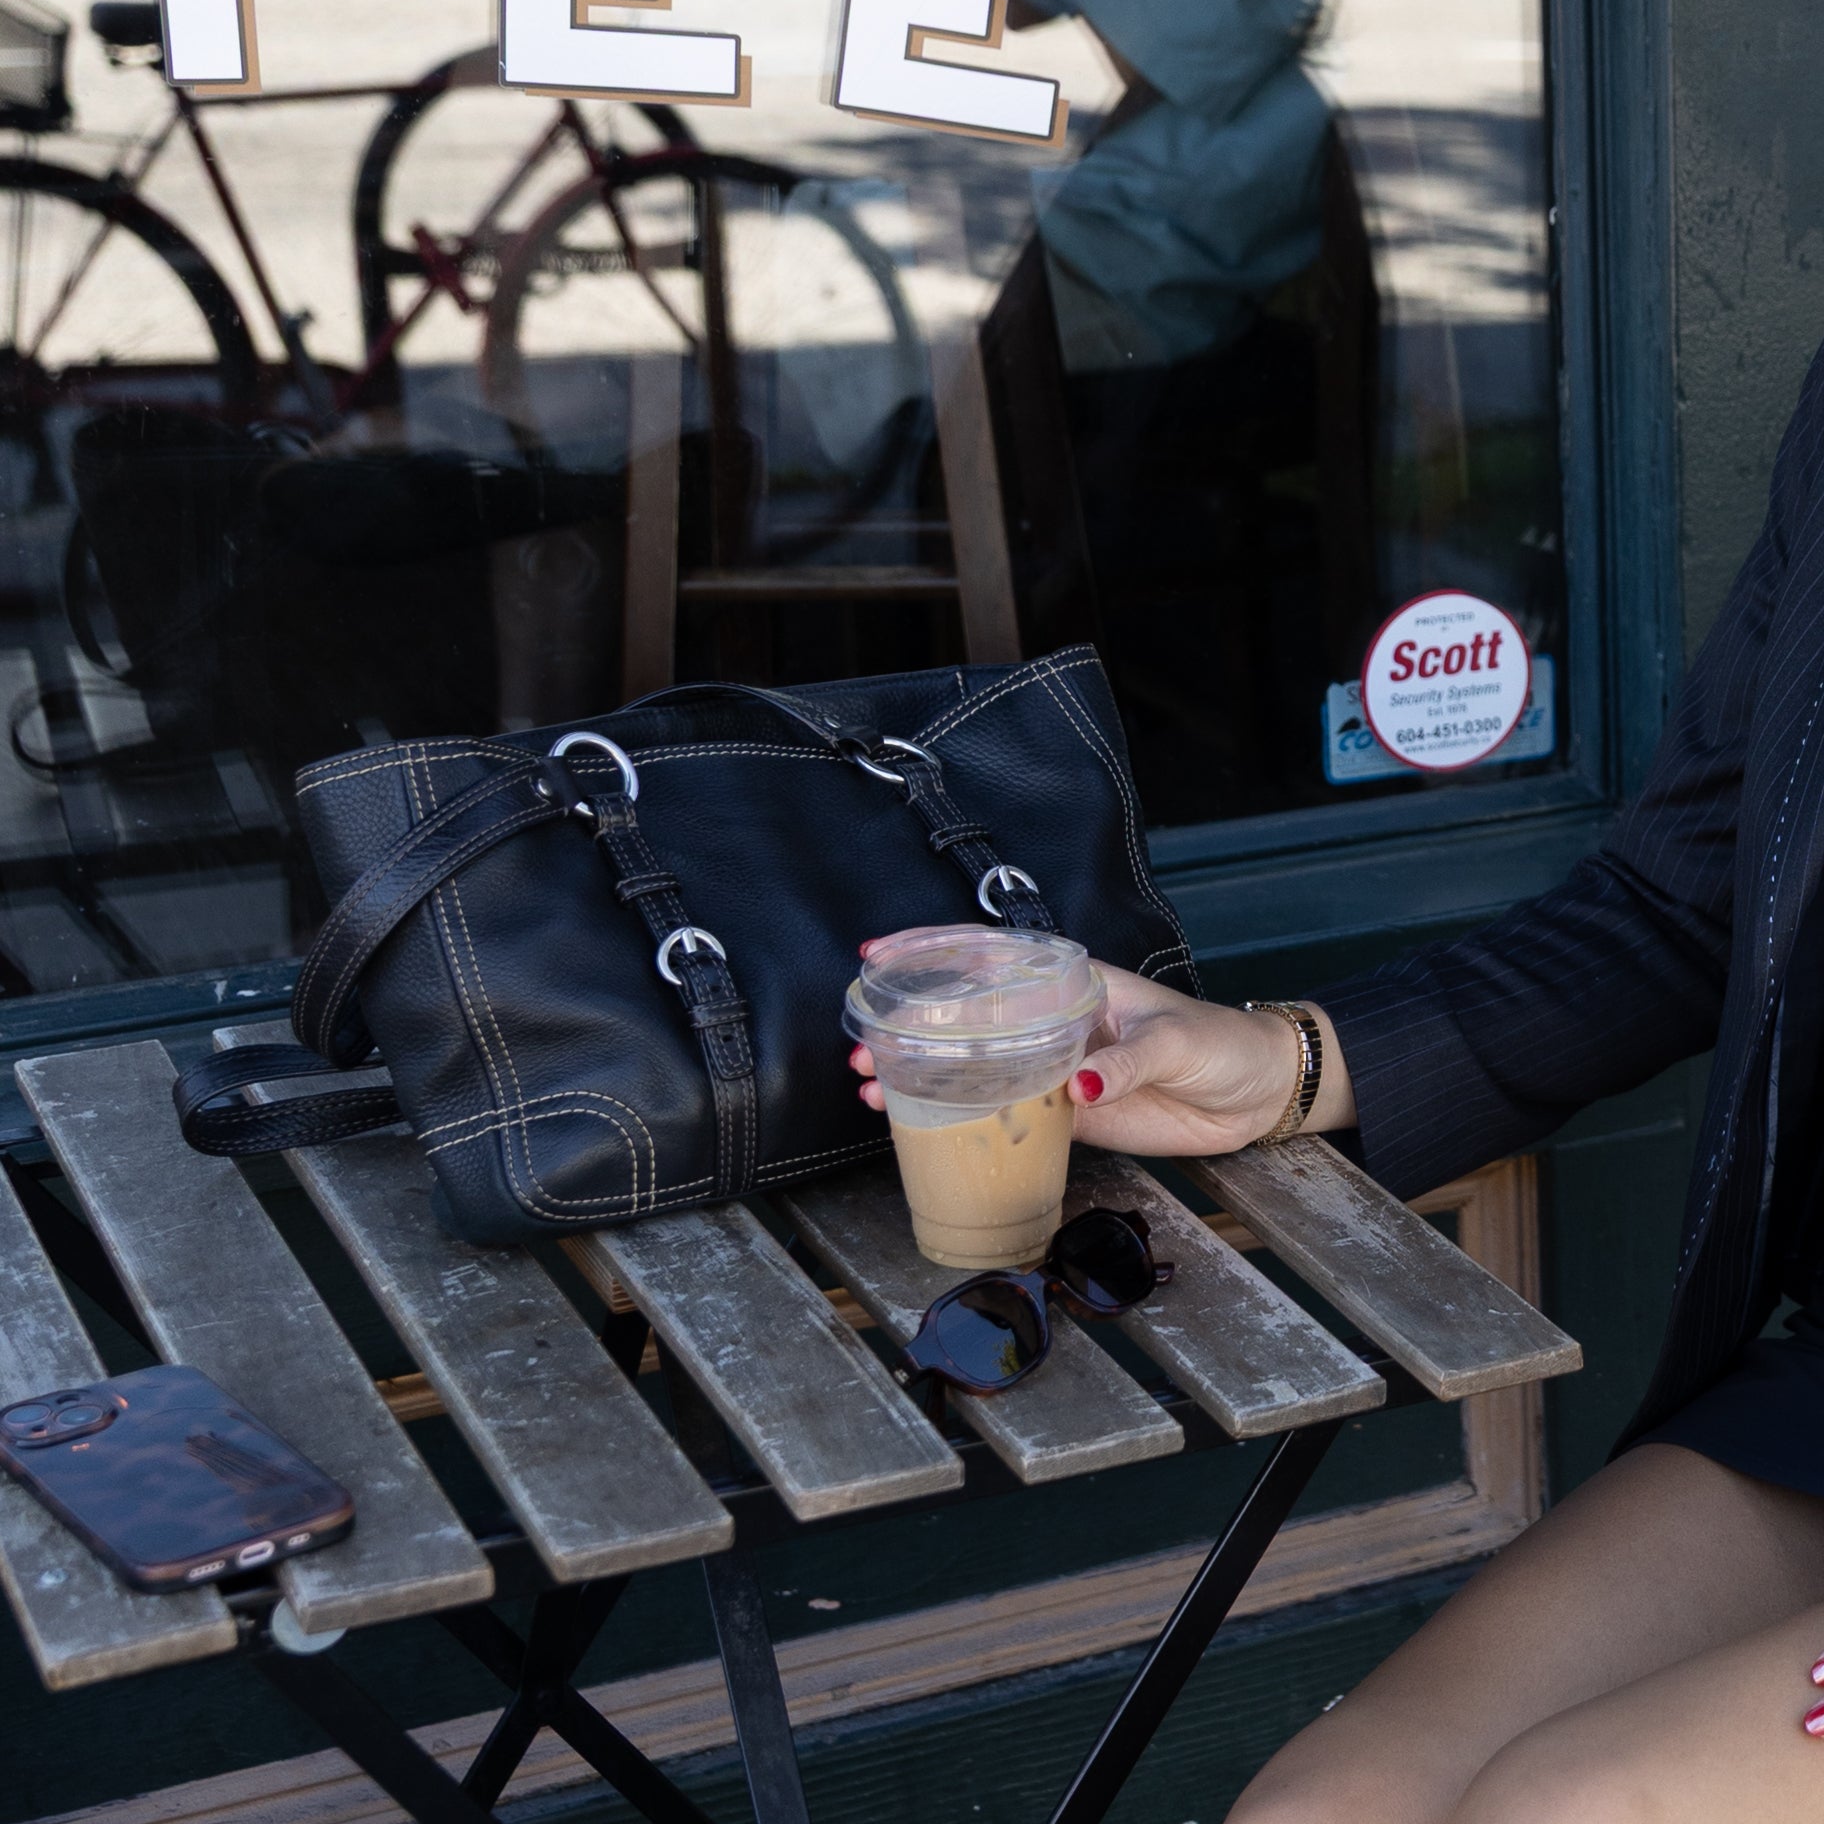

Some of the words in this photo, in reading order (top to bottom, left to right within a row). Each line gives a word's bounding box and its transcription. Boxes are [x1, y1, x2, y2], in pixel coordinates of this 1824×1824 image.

[1390, 630, 1503, 681] Scott
[1390, 689, 1443, 707] Security
[1448, 682, 1502, 701] Systems
